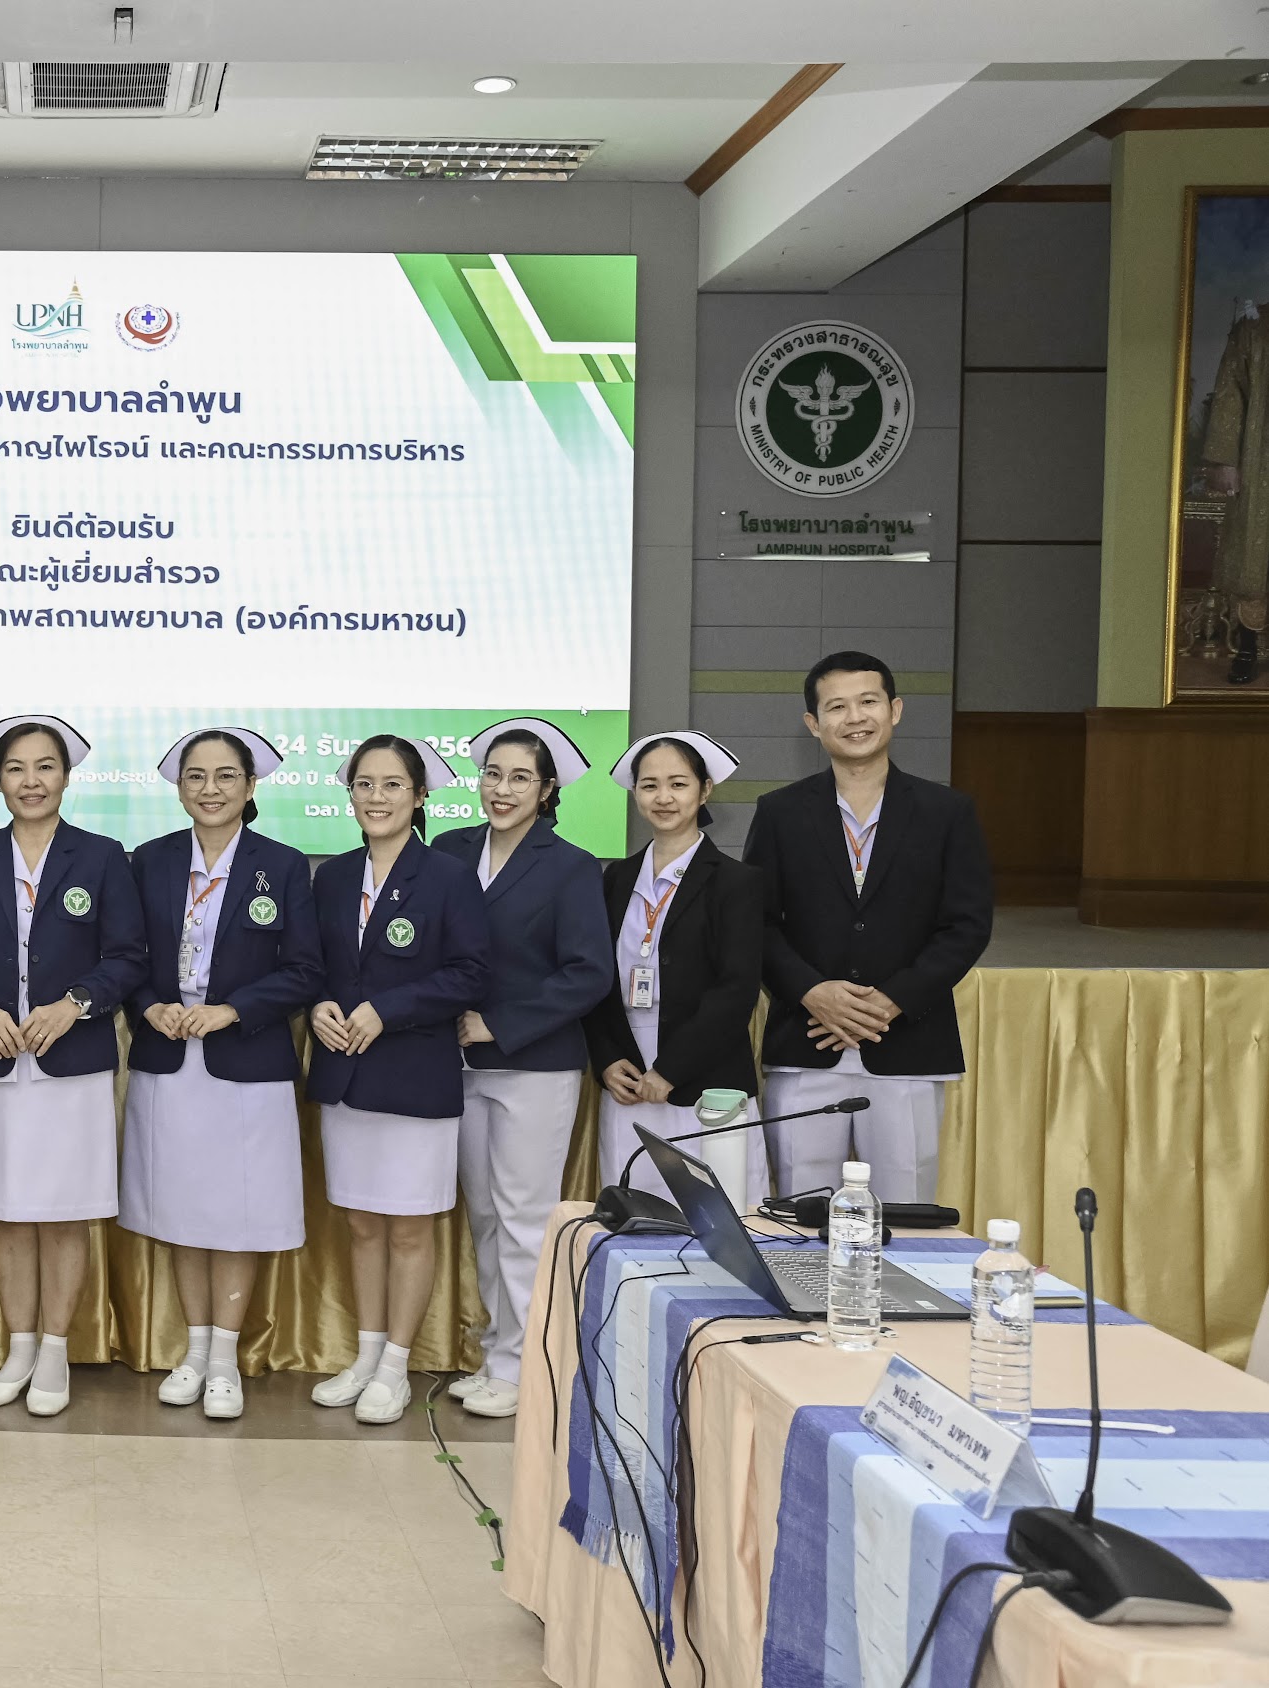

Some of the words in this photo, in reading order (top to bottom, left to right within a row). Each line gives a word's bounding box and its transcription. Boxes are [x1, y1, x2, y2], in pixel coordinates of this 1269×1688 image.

[11, 338, 88, 353] โรงพยาบาลลำพูน
[752, 330, 899, 388] กระทรวงสาธารณสุข
[161, 439, 465, 461] และคณะกรรมการบริหาร
[750, 424, 792, 476] MINISTRY
[794, 471, 812, 485] OF
[818, 466, 864, 487] PUBLIC
[867, 424, 899, 468] HEALTH
[11, 512, 174, 539] ยินดีต้อนรับ
[739, 511, 914, 543] โรงพยาบาลลำพูน
[757, 543, 822, 556] LAMPHUN
[828, 544, 893, 556] HOSPITAL
[235, 604, 466, 637] (องค์การมหาชน)
[274, 734, 307, 756] 24
[424, 735, 471, 758] 256
[304, 803, 340, 817] เวลา
[427, 803, 472, 819] 16:30
